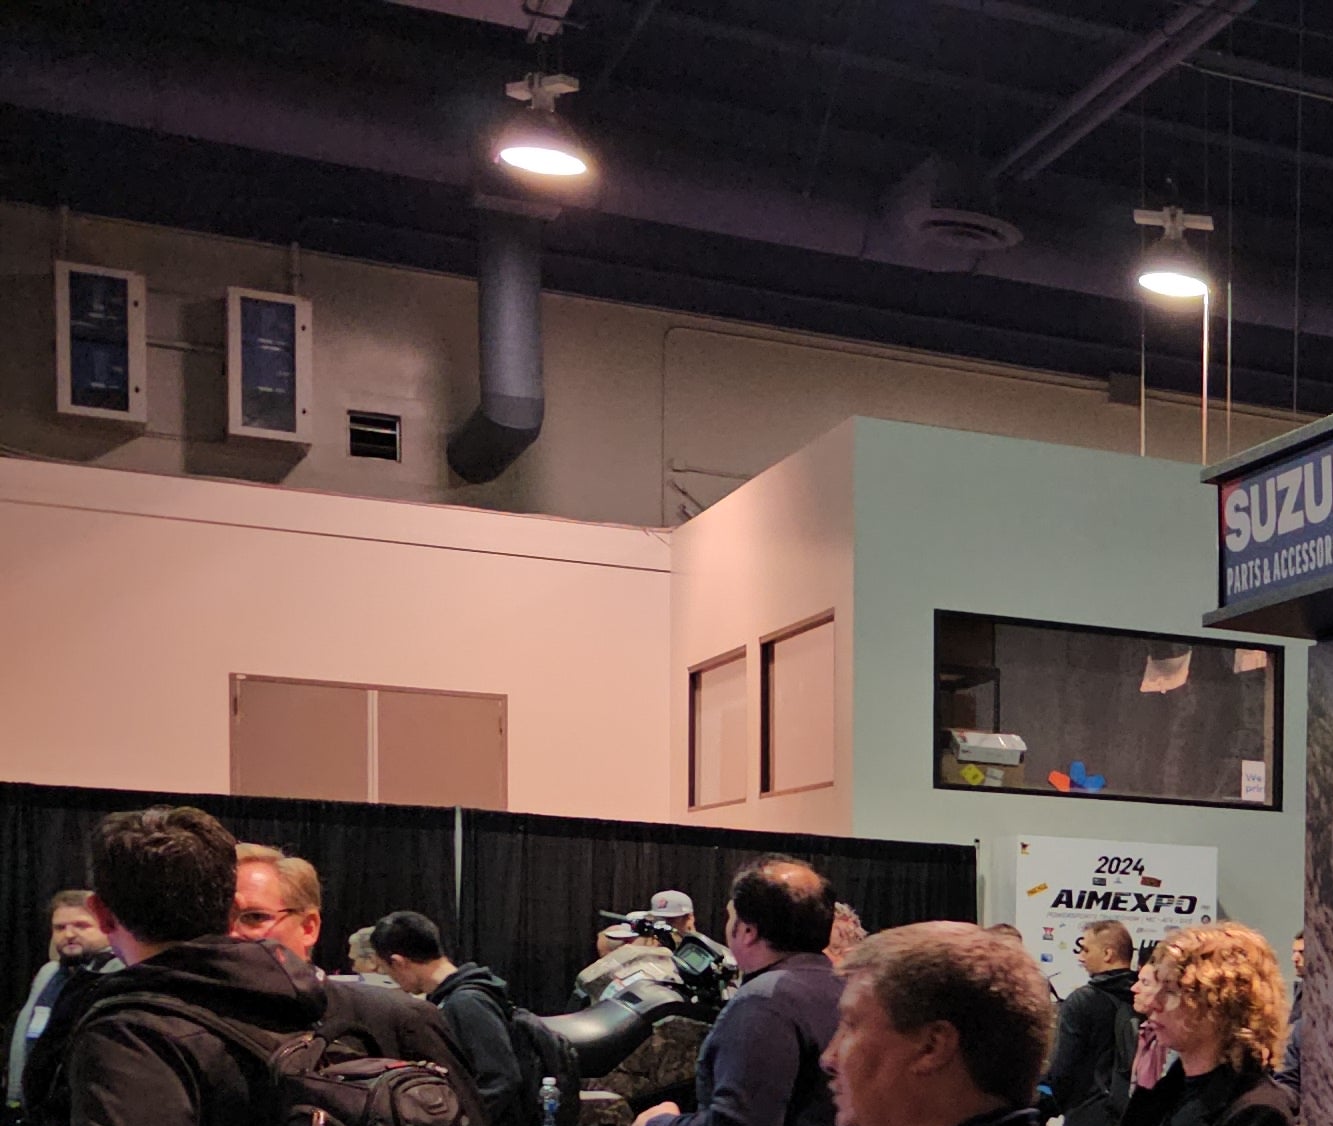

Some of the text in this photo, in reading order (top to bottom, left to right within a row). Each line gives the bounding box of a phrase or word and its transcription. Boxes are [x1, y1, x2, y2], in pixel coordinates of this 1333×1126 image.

[1226, 557, 1260, 596] PARTS
[1263, 558, 1271, 584] &
[1094, 856, 1145, 876] 2024
